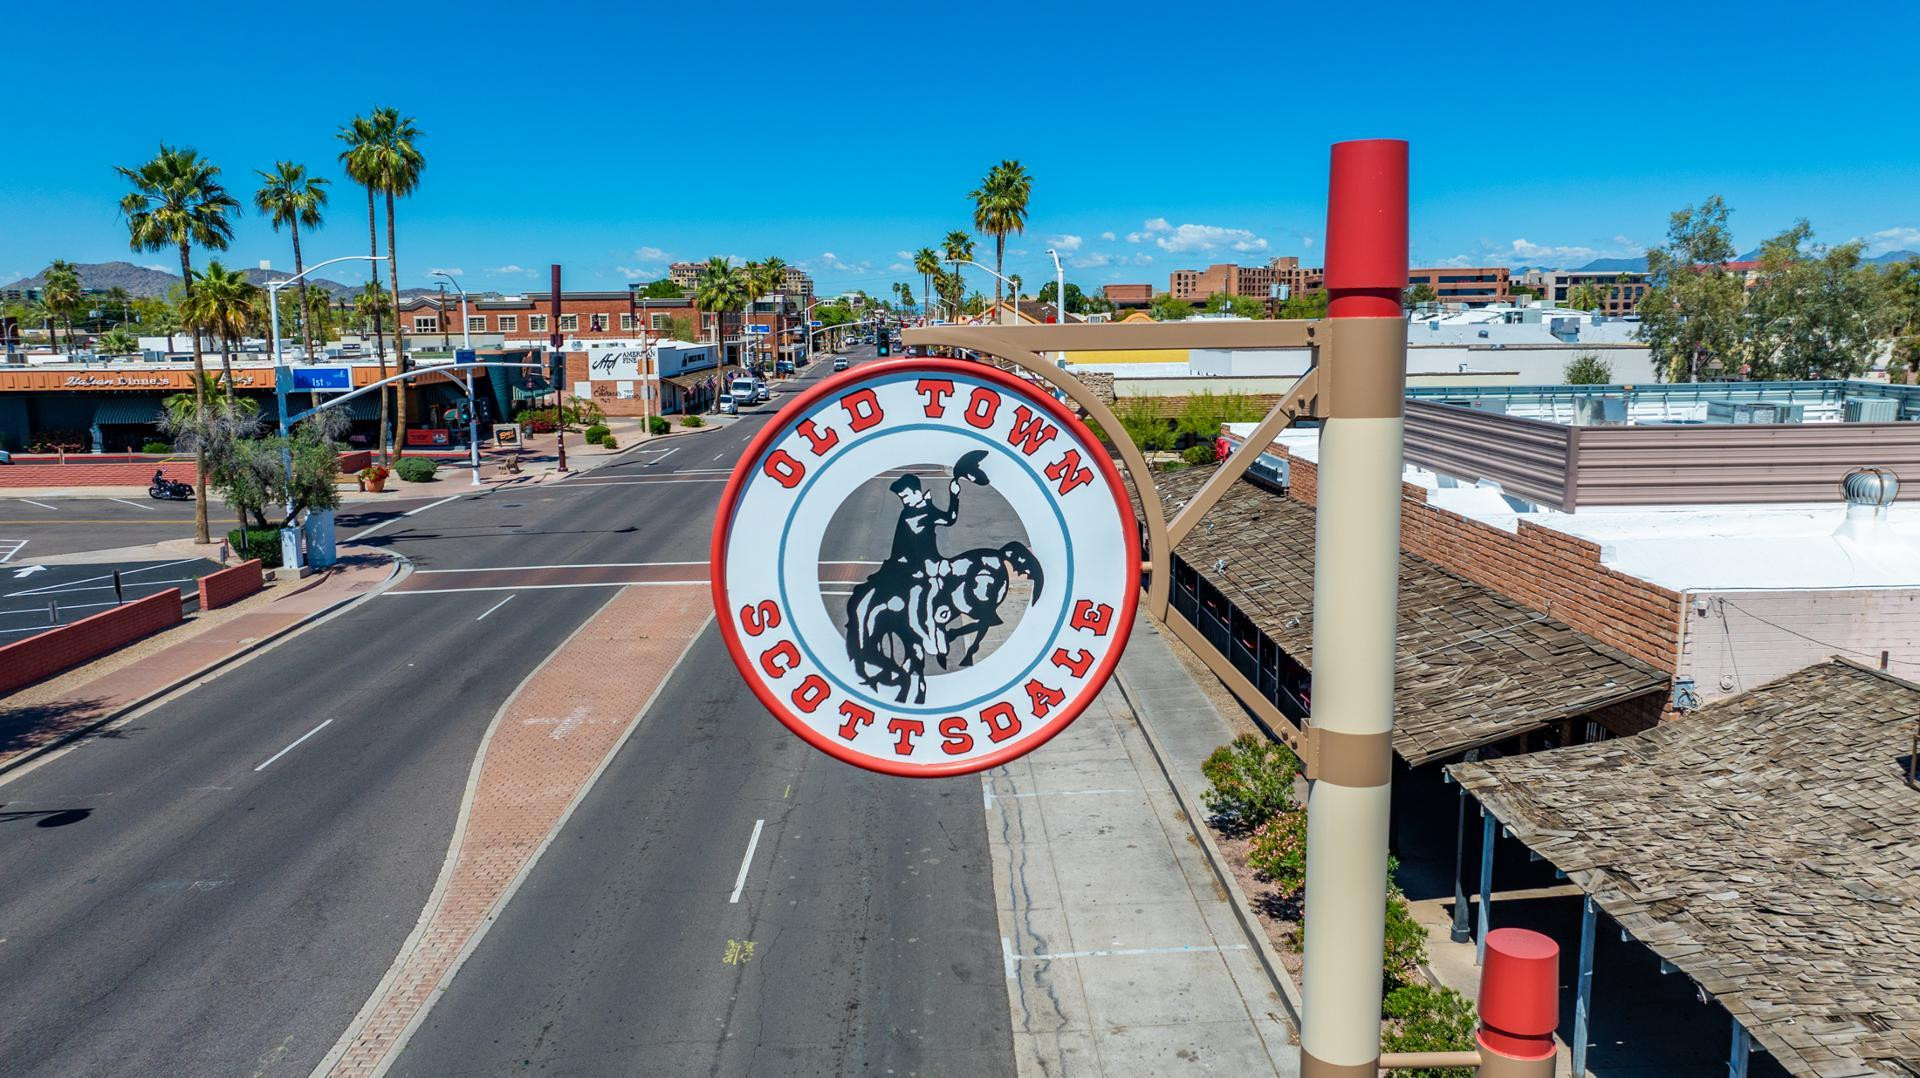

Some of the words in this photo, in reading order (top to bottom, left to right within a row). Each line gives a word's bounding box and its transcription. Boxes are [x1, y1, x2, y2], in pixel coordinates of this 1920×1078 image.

[64, 376, 113, 386] Italian
[763, 387, 885, 489] OLD
[916, 379, 1094, 496] TOWN
[739, 599, 1114, 756] SCOTTSDALE
